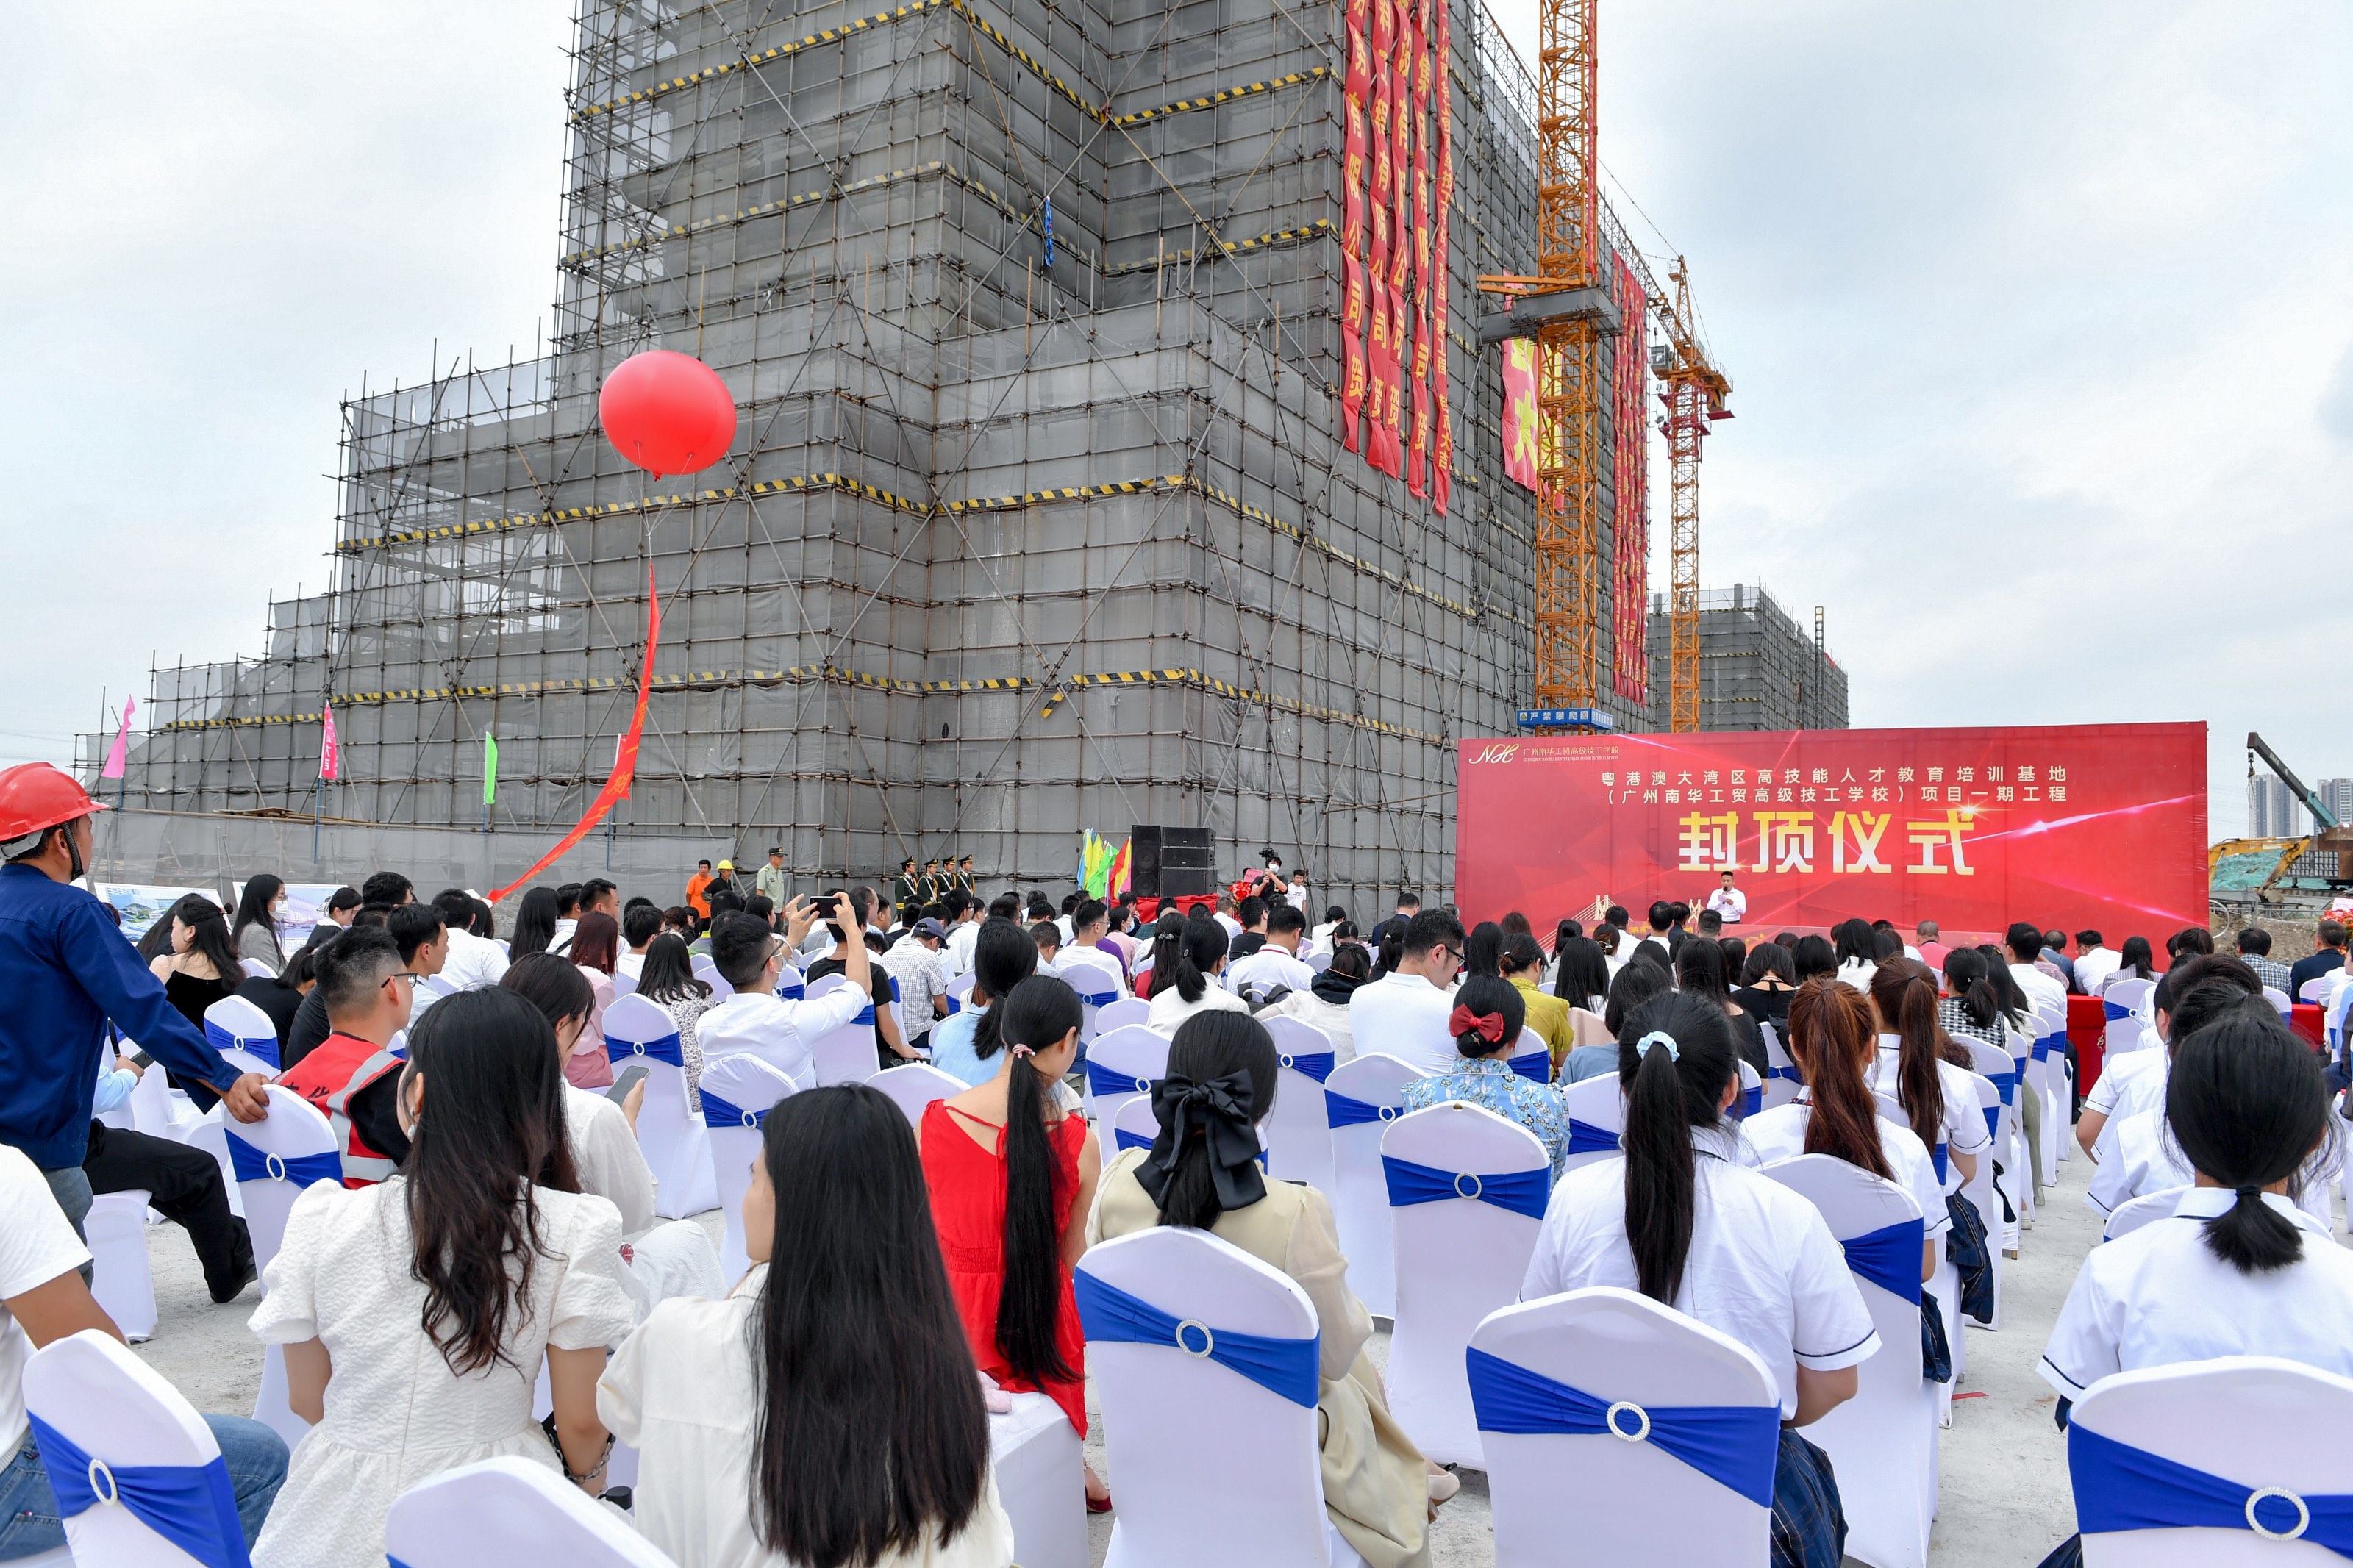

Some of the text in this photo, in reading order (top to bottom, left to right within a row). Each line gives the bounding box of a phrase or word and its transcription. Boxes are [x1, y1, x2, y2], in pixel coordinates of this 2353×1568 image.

[1529, 711, 1578, 721] 严禁攀爬
[1523, 745, 1619, 756] 广州南华工贸高级技工学校
[1601, 765, 2067, 787] 粤港澳大湾区高技能人才教育培训基地
[1678, 809, 1974, 876] 封顶仪式
